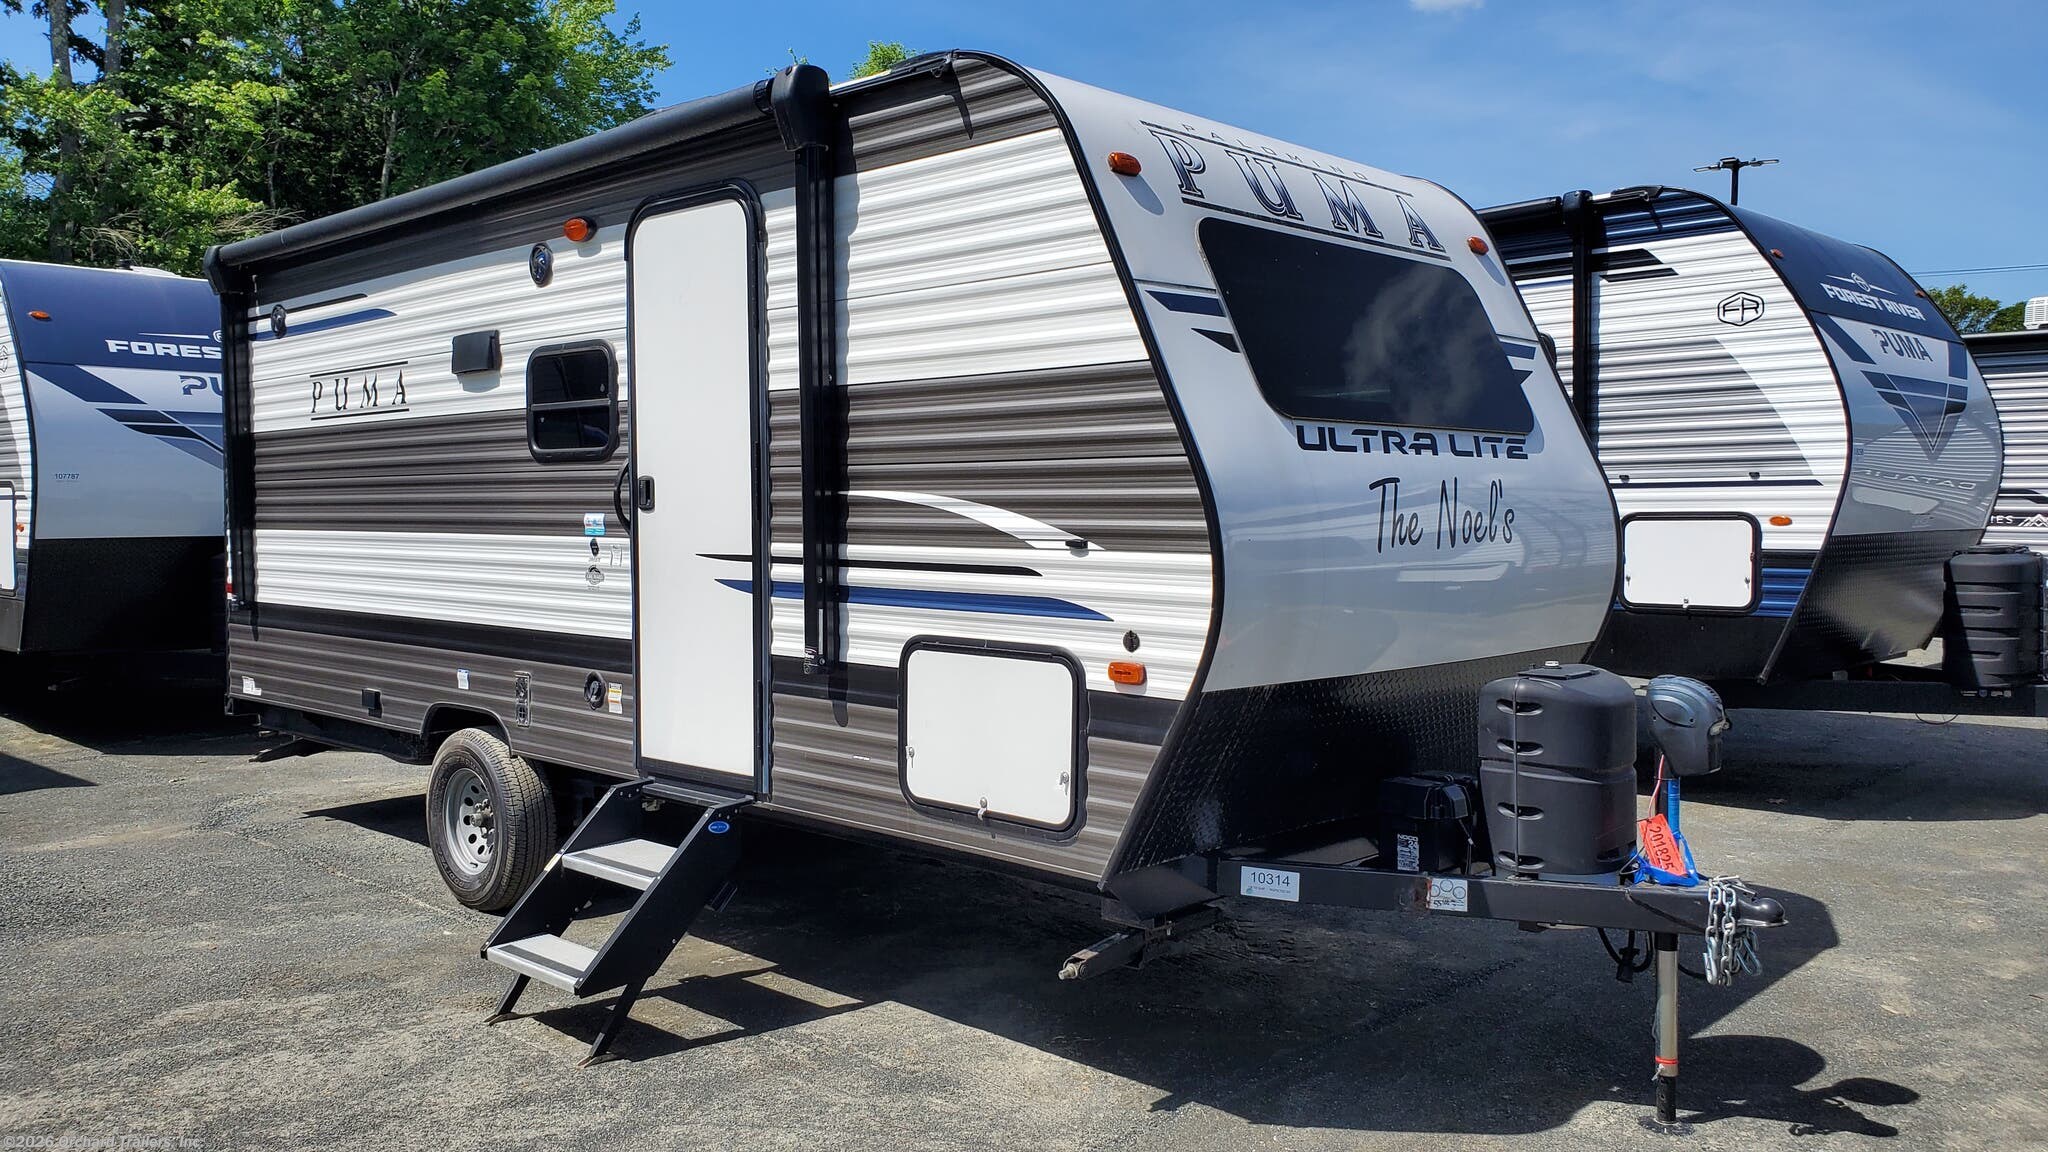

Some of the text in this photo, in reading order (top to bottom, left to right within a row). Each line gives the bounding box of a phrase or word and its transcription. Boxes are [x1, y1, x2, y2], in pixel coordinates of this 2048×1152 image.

[1147, 128, 1447, 253] PUMA
[1819, 282, 1927, 321] FOREST RIVER
[1870, 328, 1934, 362] PUMA
[310, 369, 407, 414] PUMA
[1295, 425, 1529, 460] ULTRA LITE
[1368, 477, 1515, 554] The Noel's
[1251, 871, 1290, 887] 10314
